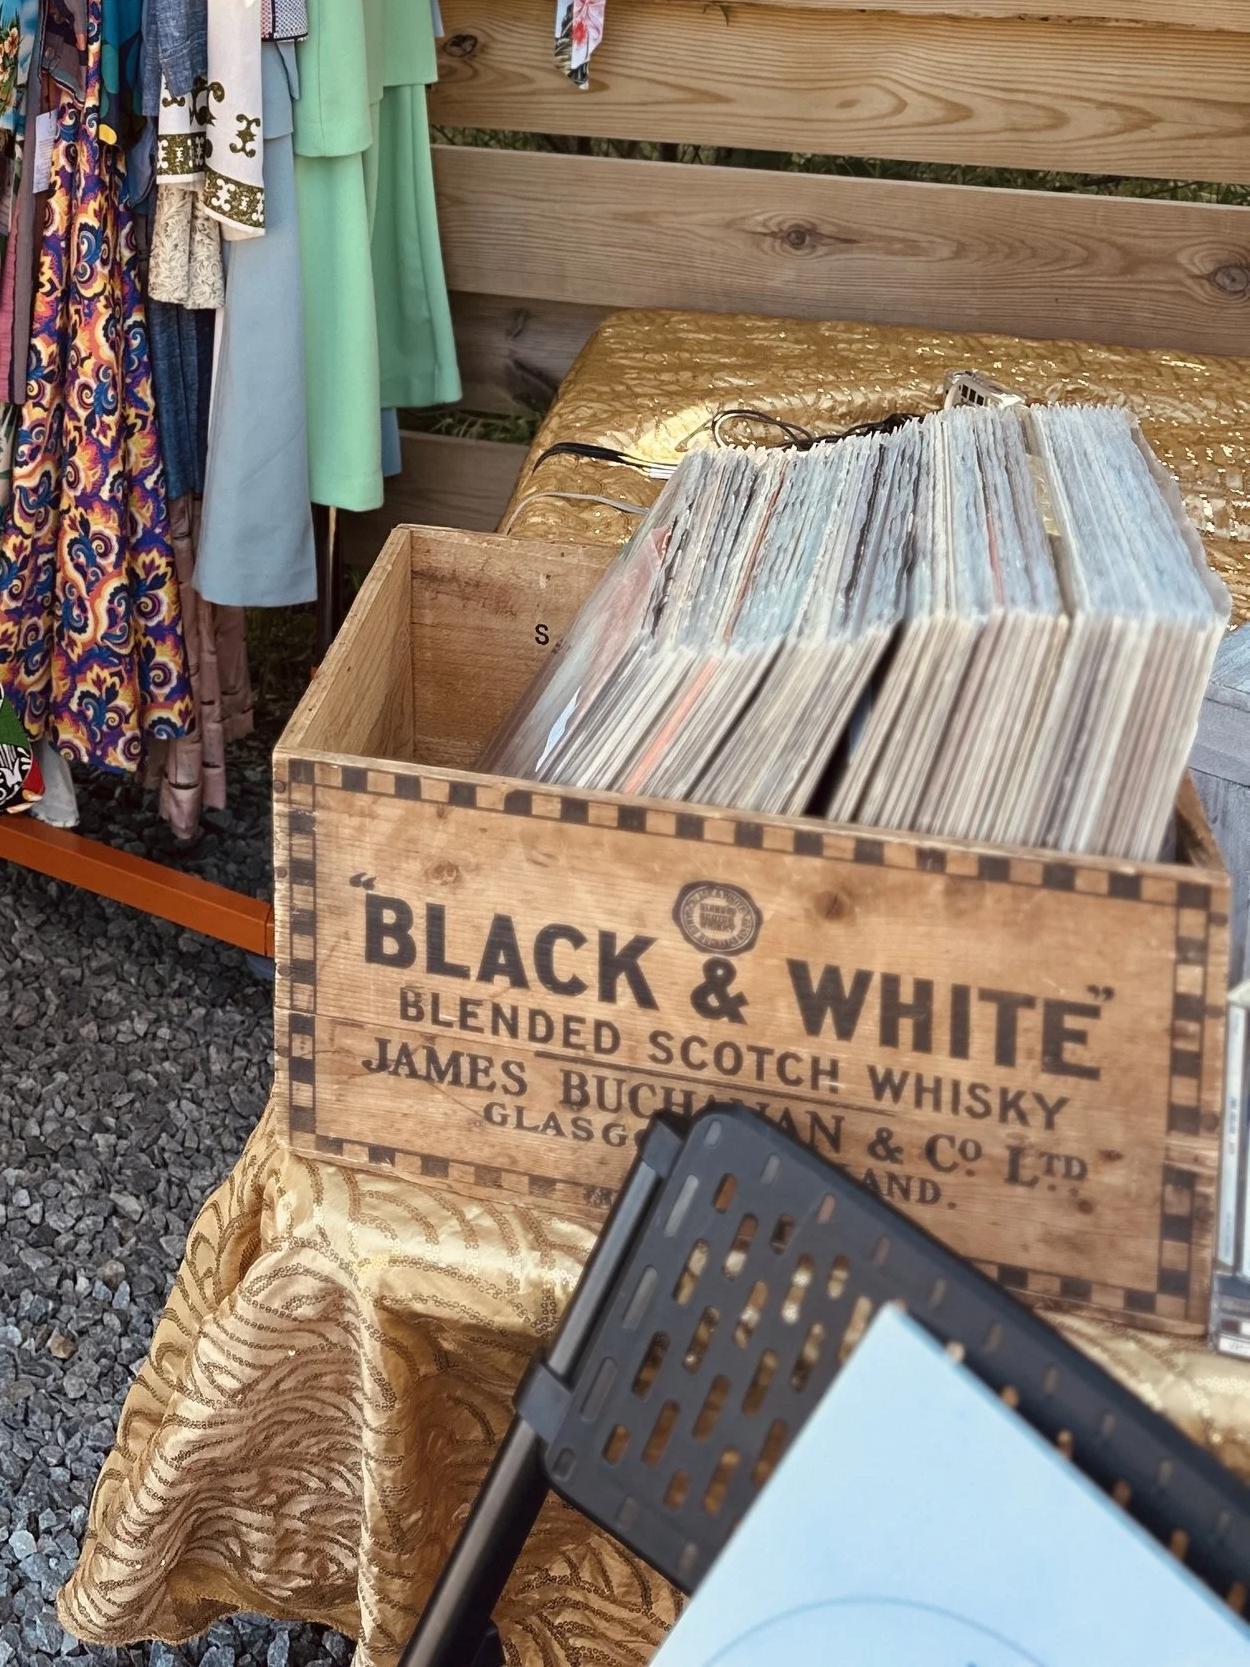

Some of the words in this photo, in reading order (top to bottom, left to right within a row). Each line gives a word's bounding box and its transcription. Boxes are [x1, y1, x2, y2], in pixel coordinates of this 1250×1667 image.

[689, 956, 750, 1026] &
[361, 1036, 529, 1097] JAMES
[559, 1068, 846, 1155] BUCHAN
[867, 1126, 905, 1165] &
[399, 986, 621, 1056] BLENDED
[647, 1029, 841, 1095] SCOTCH
[866, 1063, 1070, 1132] WHISKY
